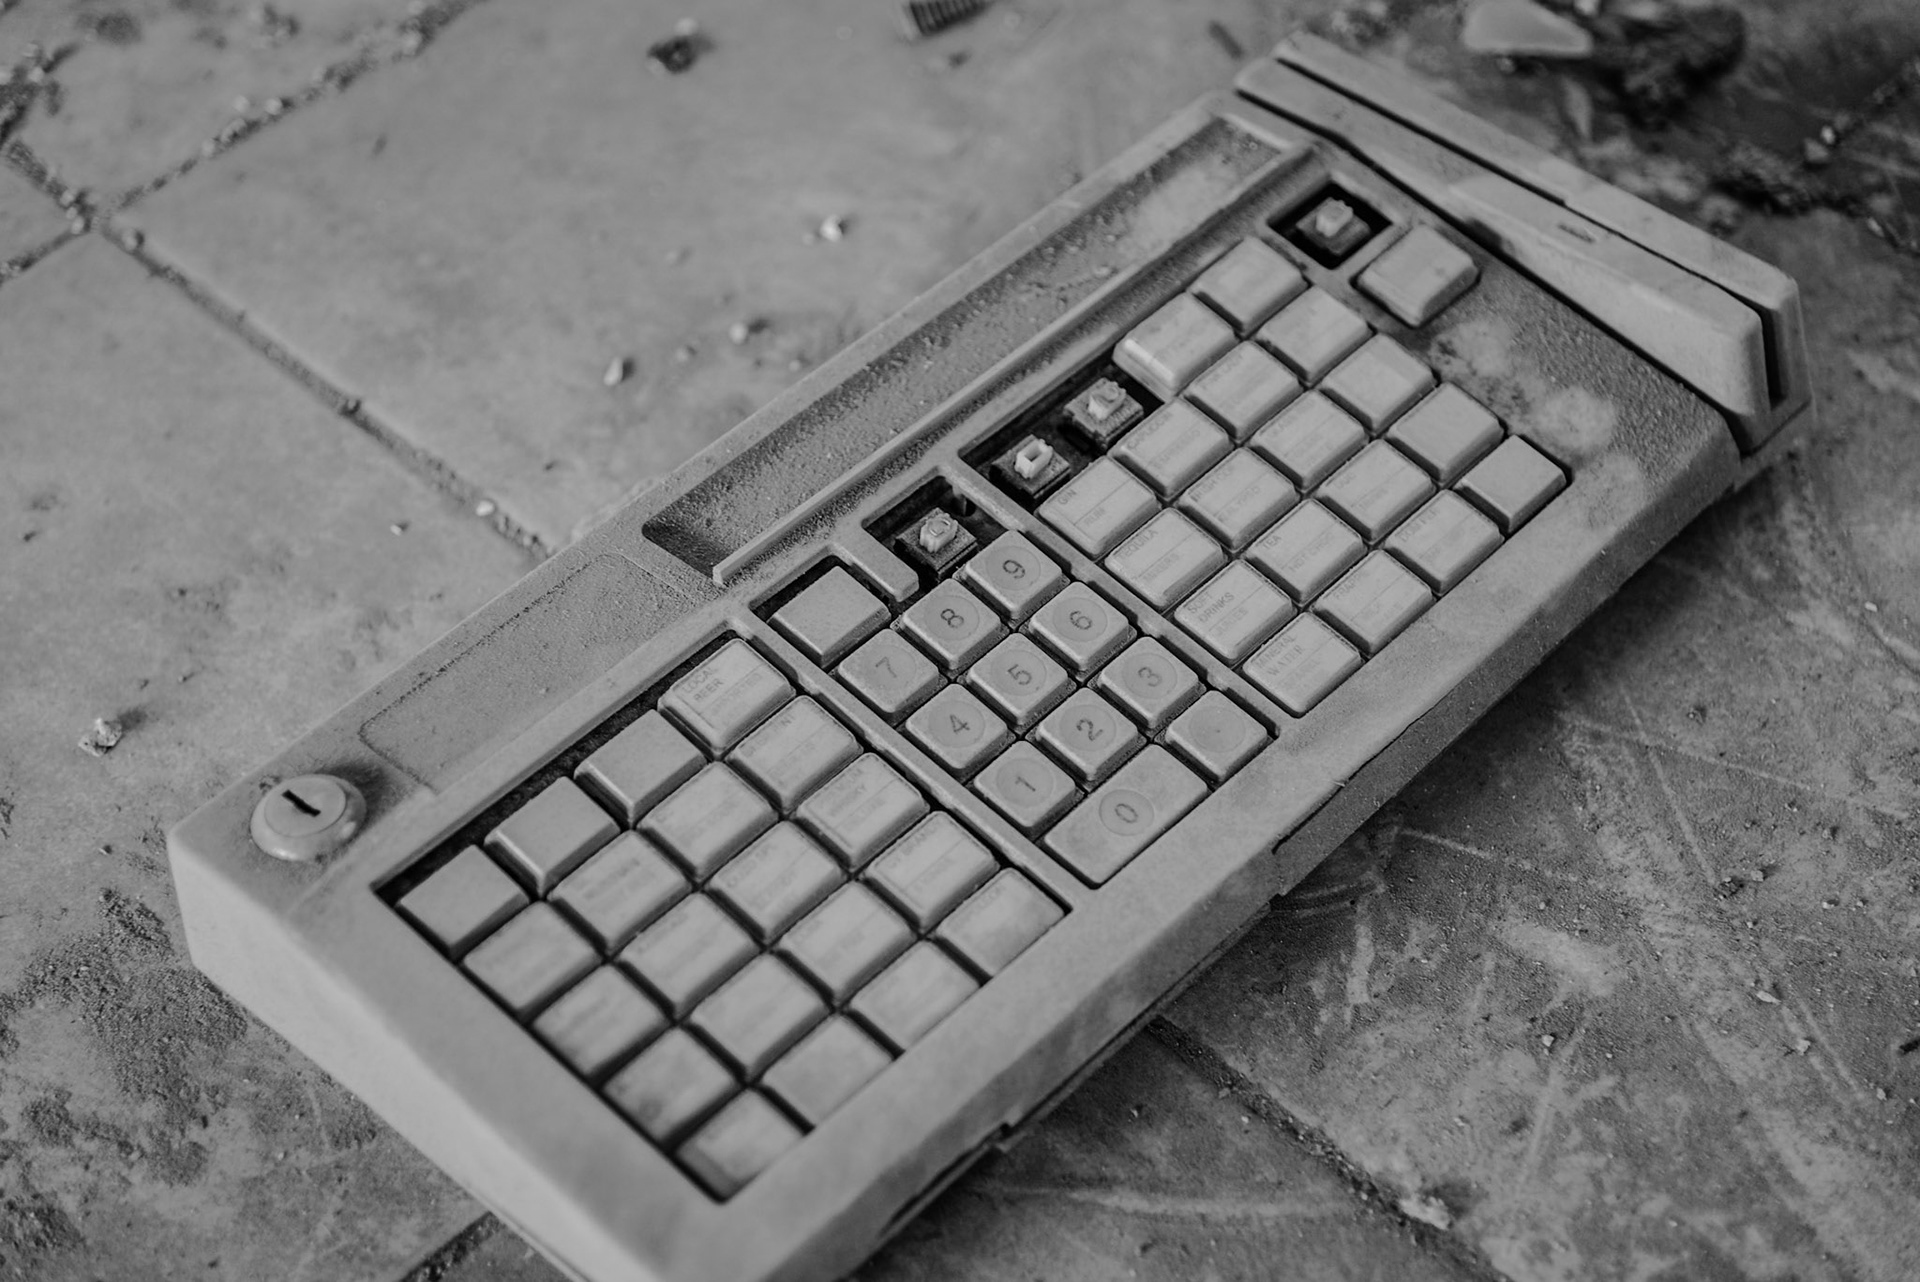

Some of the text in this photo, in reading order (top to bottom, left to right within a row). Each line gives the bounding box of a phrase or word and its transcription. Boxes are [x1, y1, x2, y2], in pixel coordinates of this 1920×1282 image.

[1055, 488, 1079, 506] GIN
[1116, 527, 1160, 561] TEQUILA
[1261, 533, 1283, 550] TEA
[1003, 559, 1026, 579] 9
[1185, 591, 1215, 615] SOFT
[1195, 591, 1236, 623] DRINKS
[940, 607, 964, 629] 8
[1069, 610, 1092, 630] 6
[1252, 631, 1298, 668] MINERAL
[1265, 644, 1306, 677] WATER
[875, 656, 898, 679] 7
[1007, 664, 1032, 686] 5
[1138, 666, 1161, 687] 3
[680, 664, 719, 694] LOCAL
[690, 676, 725, 703] BEER
[949, 713, 970, 734] 4
[1076, 718, 1103, 740] 2
[1015, 776, 1037, 793] 1
[1114, 803, 1139, 824] 0
